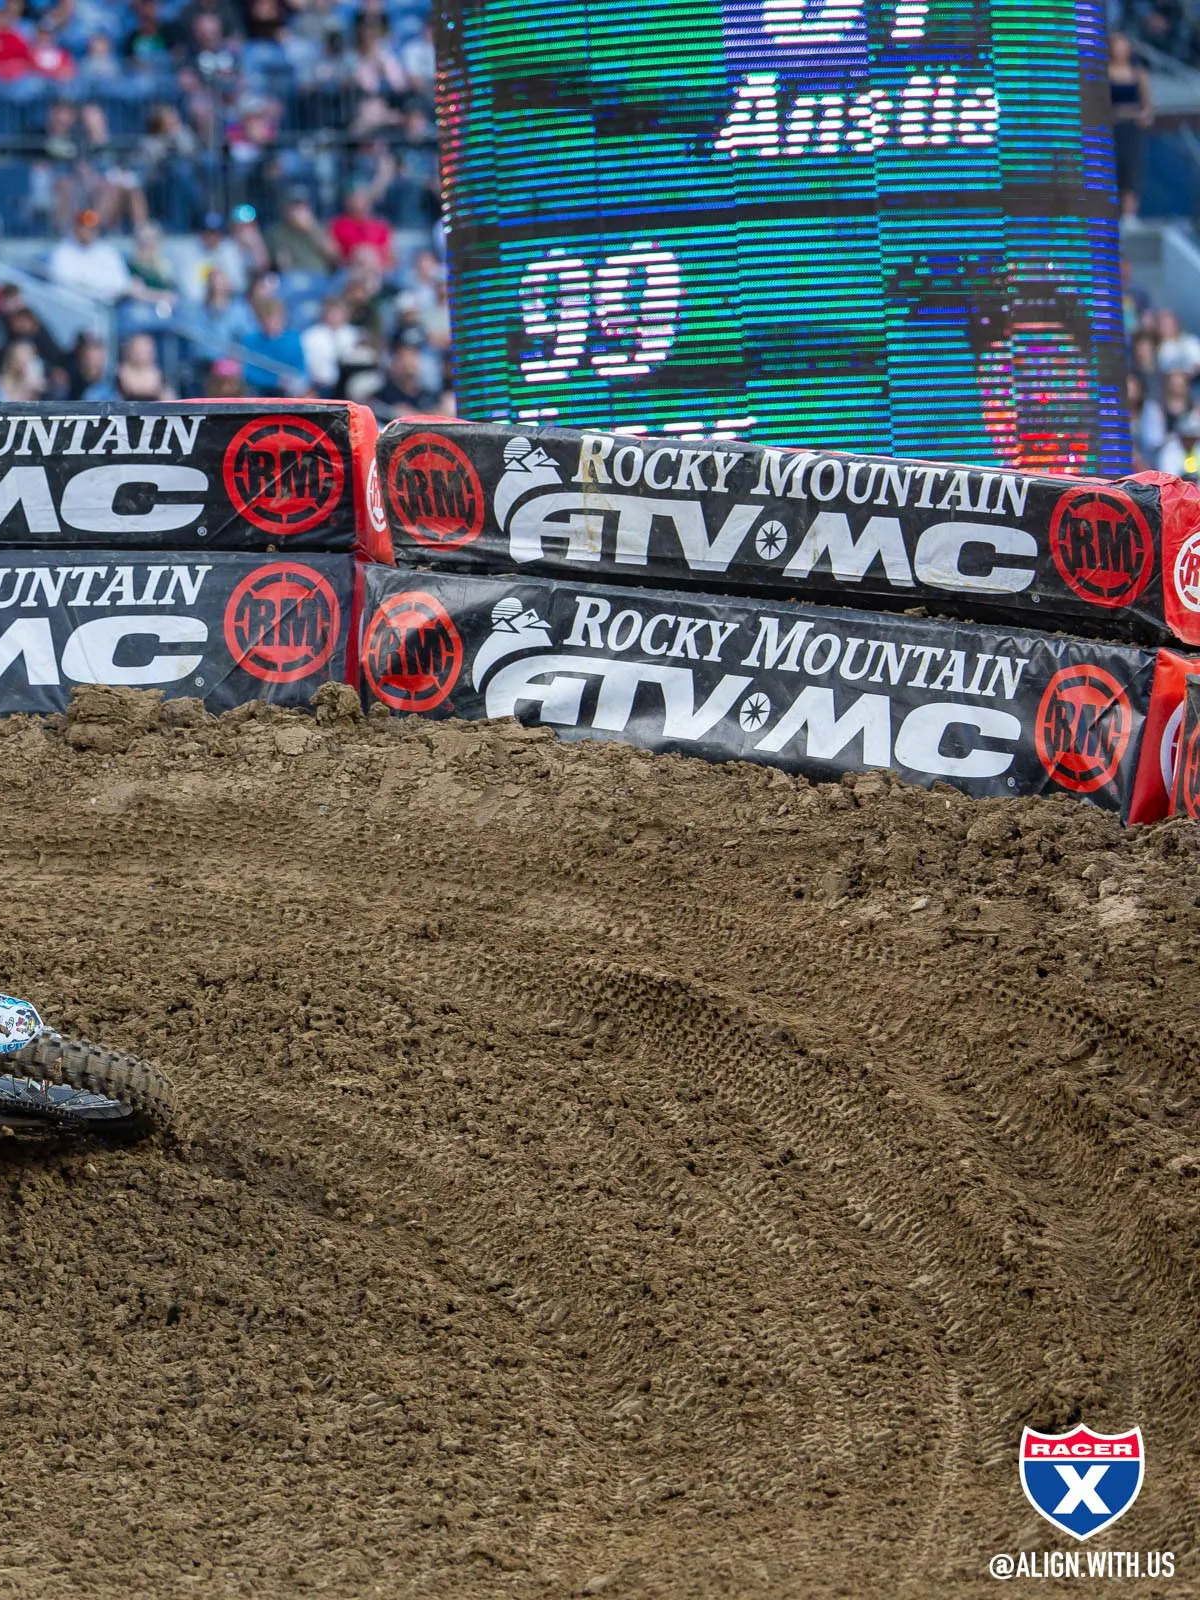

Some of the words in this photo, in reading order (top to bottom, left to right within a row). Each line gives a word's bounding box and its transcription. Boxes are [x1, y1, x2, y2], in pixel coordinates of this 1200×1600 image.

[247, 450, 320, 500] RM
[403, 468, 468, 520] RM
[570, 434, 747, 493] ROCKY
[750, 449, 1039, 517] MOUNTAIN
[1067, 517, 1133, 574] RM
[250, 597, 322, 648] RM
[562, 595, 741, 663] ROCKY
[740, 615, 1030, 700] MOUNTAIN
[377, 626, 445, 676] RM
